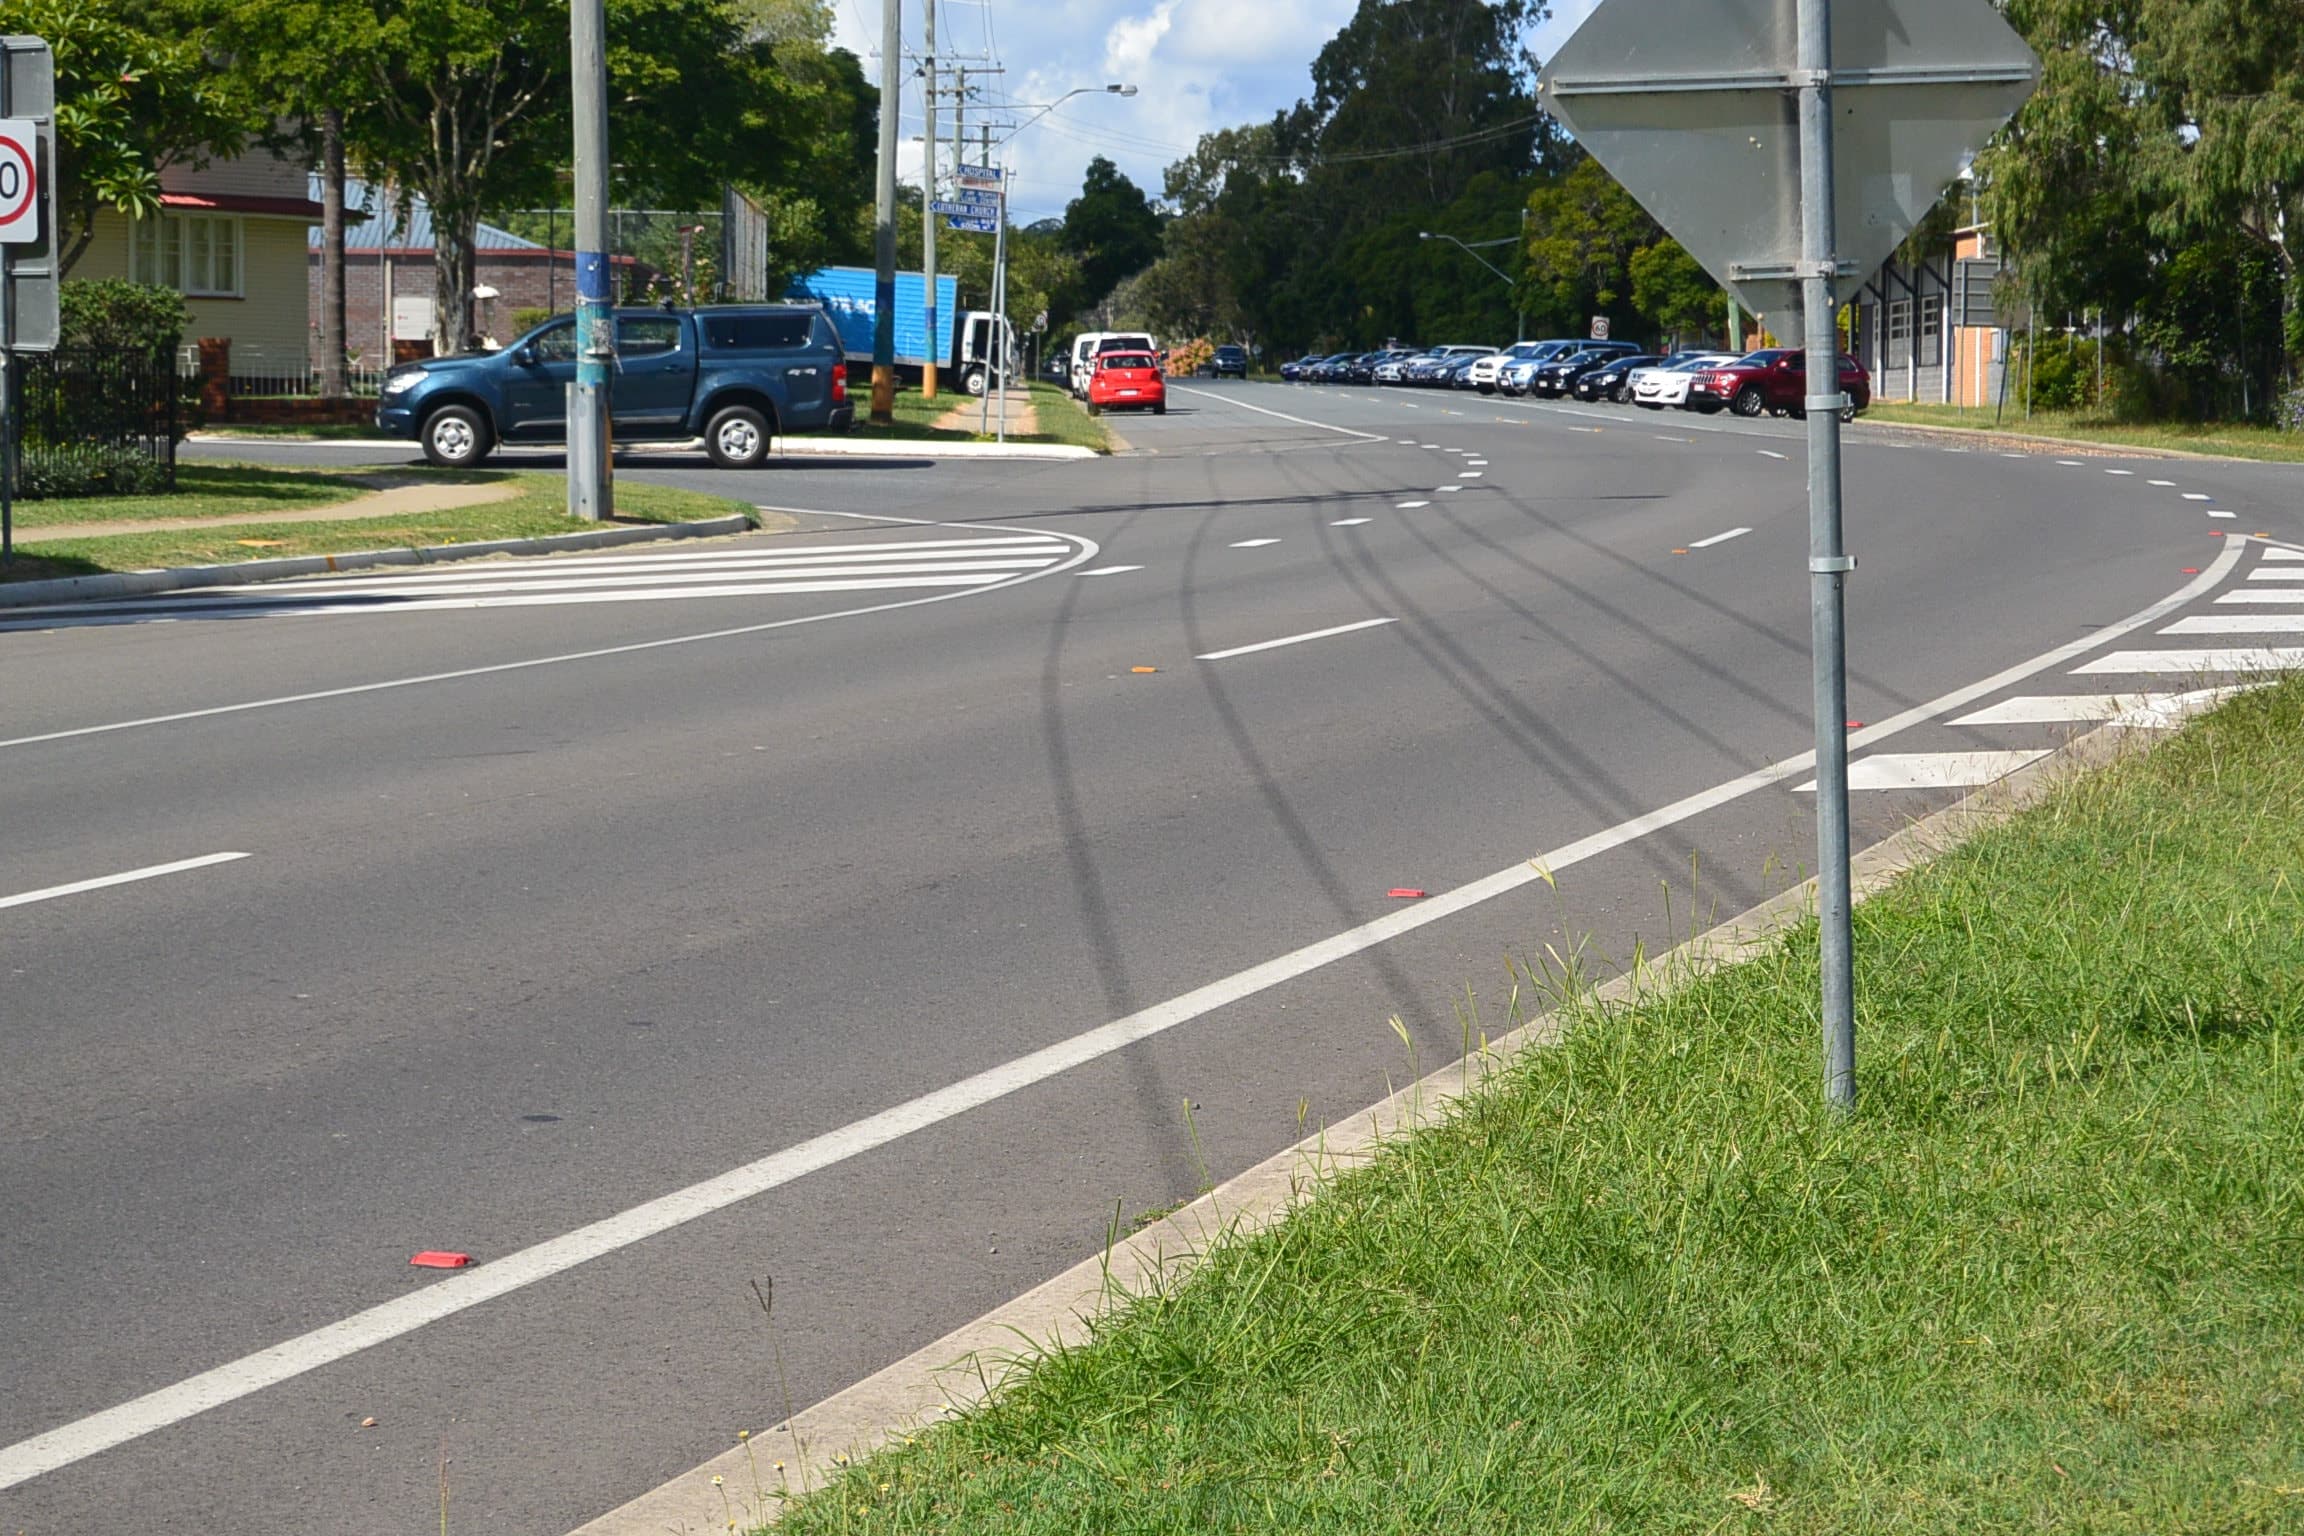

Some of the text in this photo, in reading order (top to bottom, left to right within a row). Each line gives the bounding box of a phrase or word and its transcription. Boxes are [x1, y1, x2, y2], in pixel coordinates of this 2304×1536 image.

[965, 167, 996, 178] HOSPITAL
[0, 161, 19, 199] 0
[937, 202, 995, 217] LUTHERAN CHURCH
[1595, 324, 1606, 333] 60
